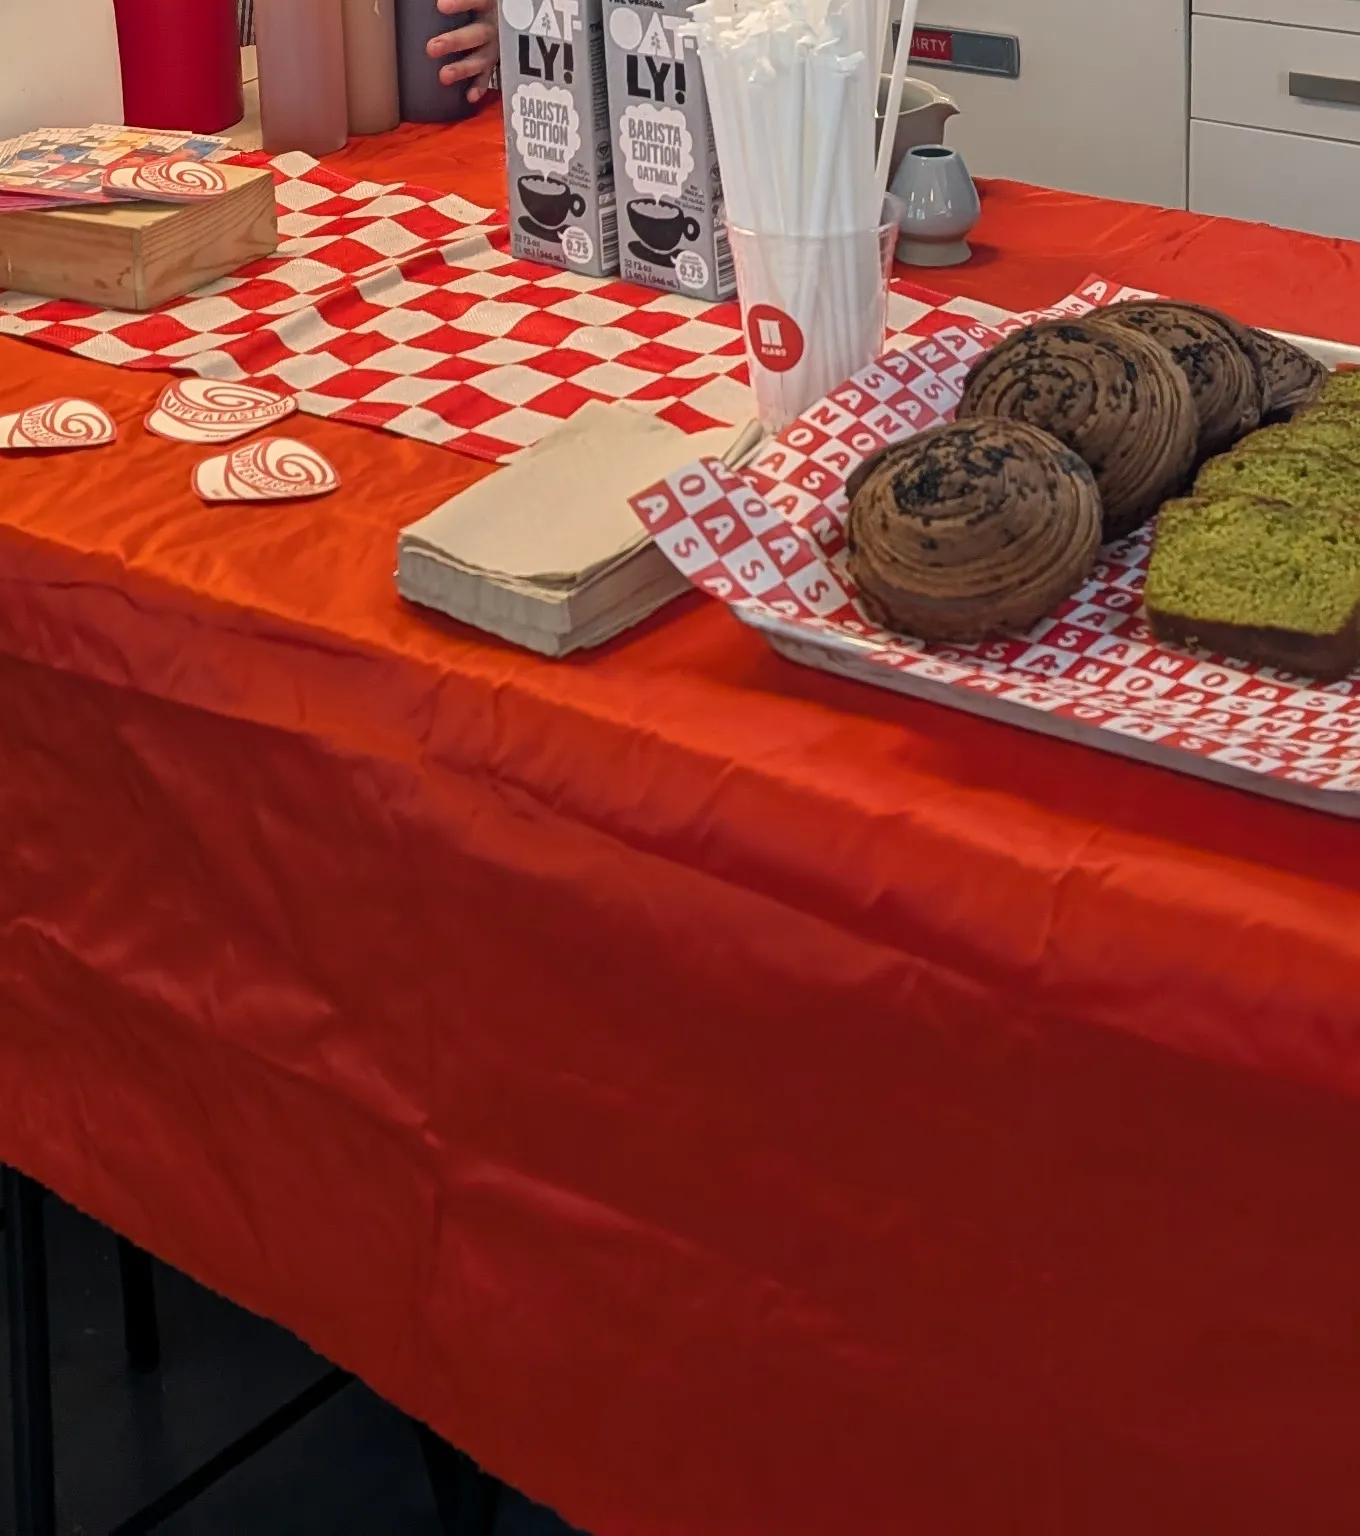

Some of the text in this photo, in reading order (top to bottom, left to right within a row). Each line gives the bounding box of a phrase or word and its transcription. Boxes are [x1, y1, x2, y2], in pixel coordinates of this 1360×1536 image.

[518, 34, 575, 85] LY!
[626, 54, 687, 105] LY!
[519, 96, 570, 126] BARISTA
[522, 117, 569, 148] EDITION
[628, 117, 682, 148] BARISTA
[527, 142, 566, 164] OATMILK
[631, 138, 681, 169] EDITION
[637, 164, 679, 187] OATMILK
[566, 238, 589, 255] 0.75
[679, 263, 704, 279] 0.75
